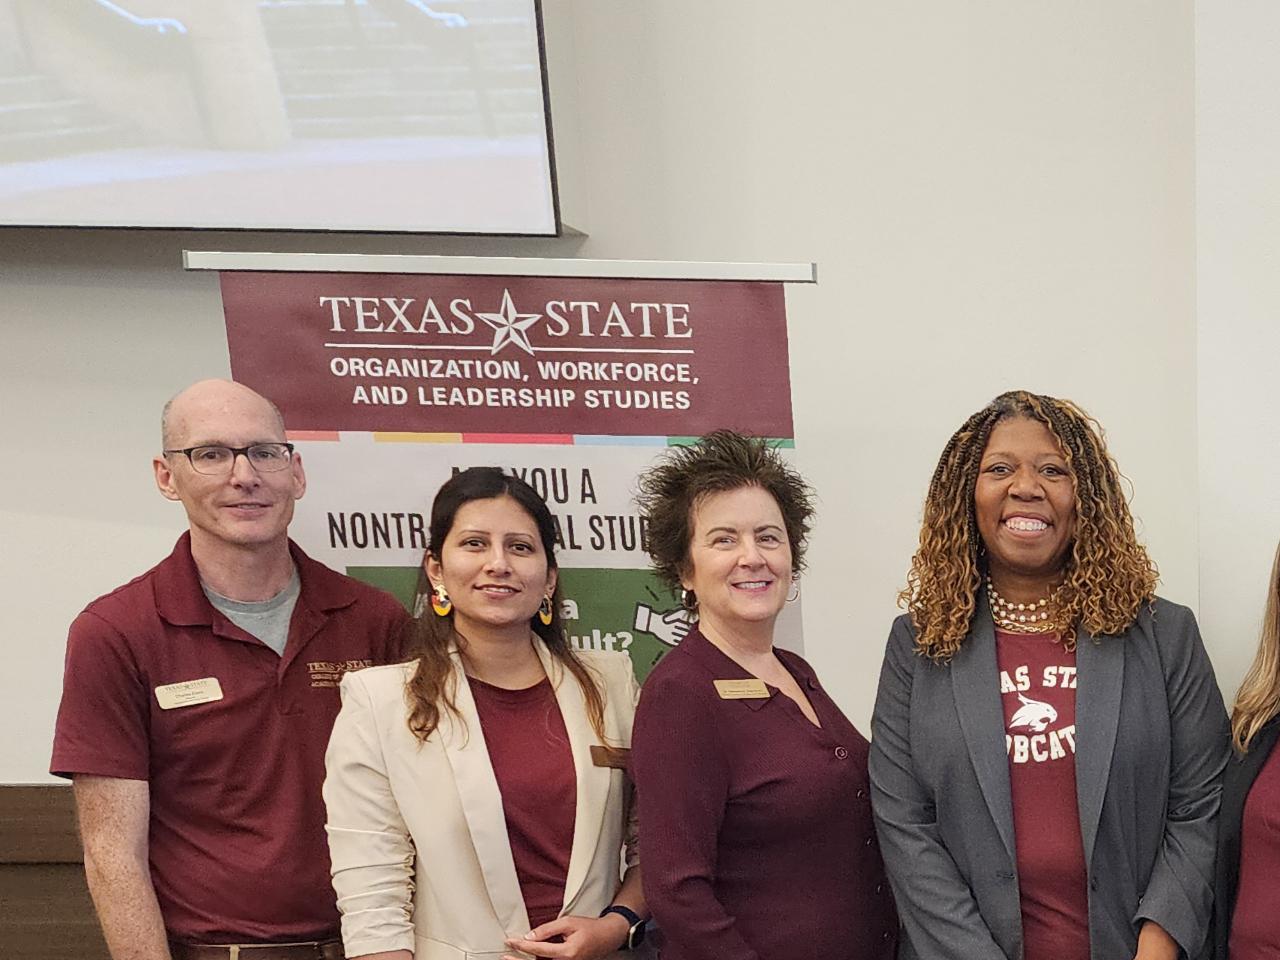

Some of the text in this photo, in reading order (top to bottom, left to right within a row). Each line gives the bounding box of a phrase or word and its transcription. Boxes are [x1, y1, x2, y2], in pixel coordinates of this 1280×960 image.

[319, 296, 693, 338] TEXAS STATE
[330, 357, 699, 385] ORGANIZATION, WORKFORCE,
[352, 385, 690, 410] AND LEADERSHIP STUDIES
[580, 468, 597, 504] A
[570, 629, 633, 656] ult?
[1006, 725, 1075, 763] BCAT
